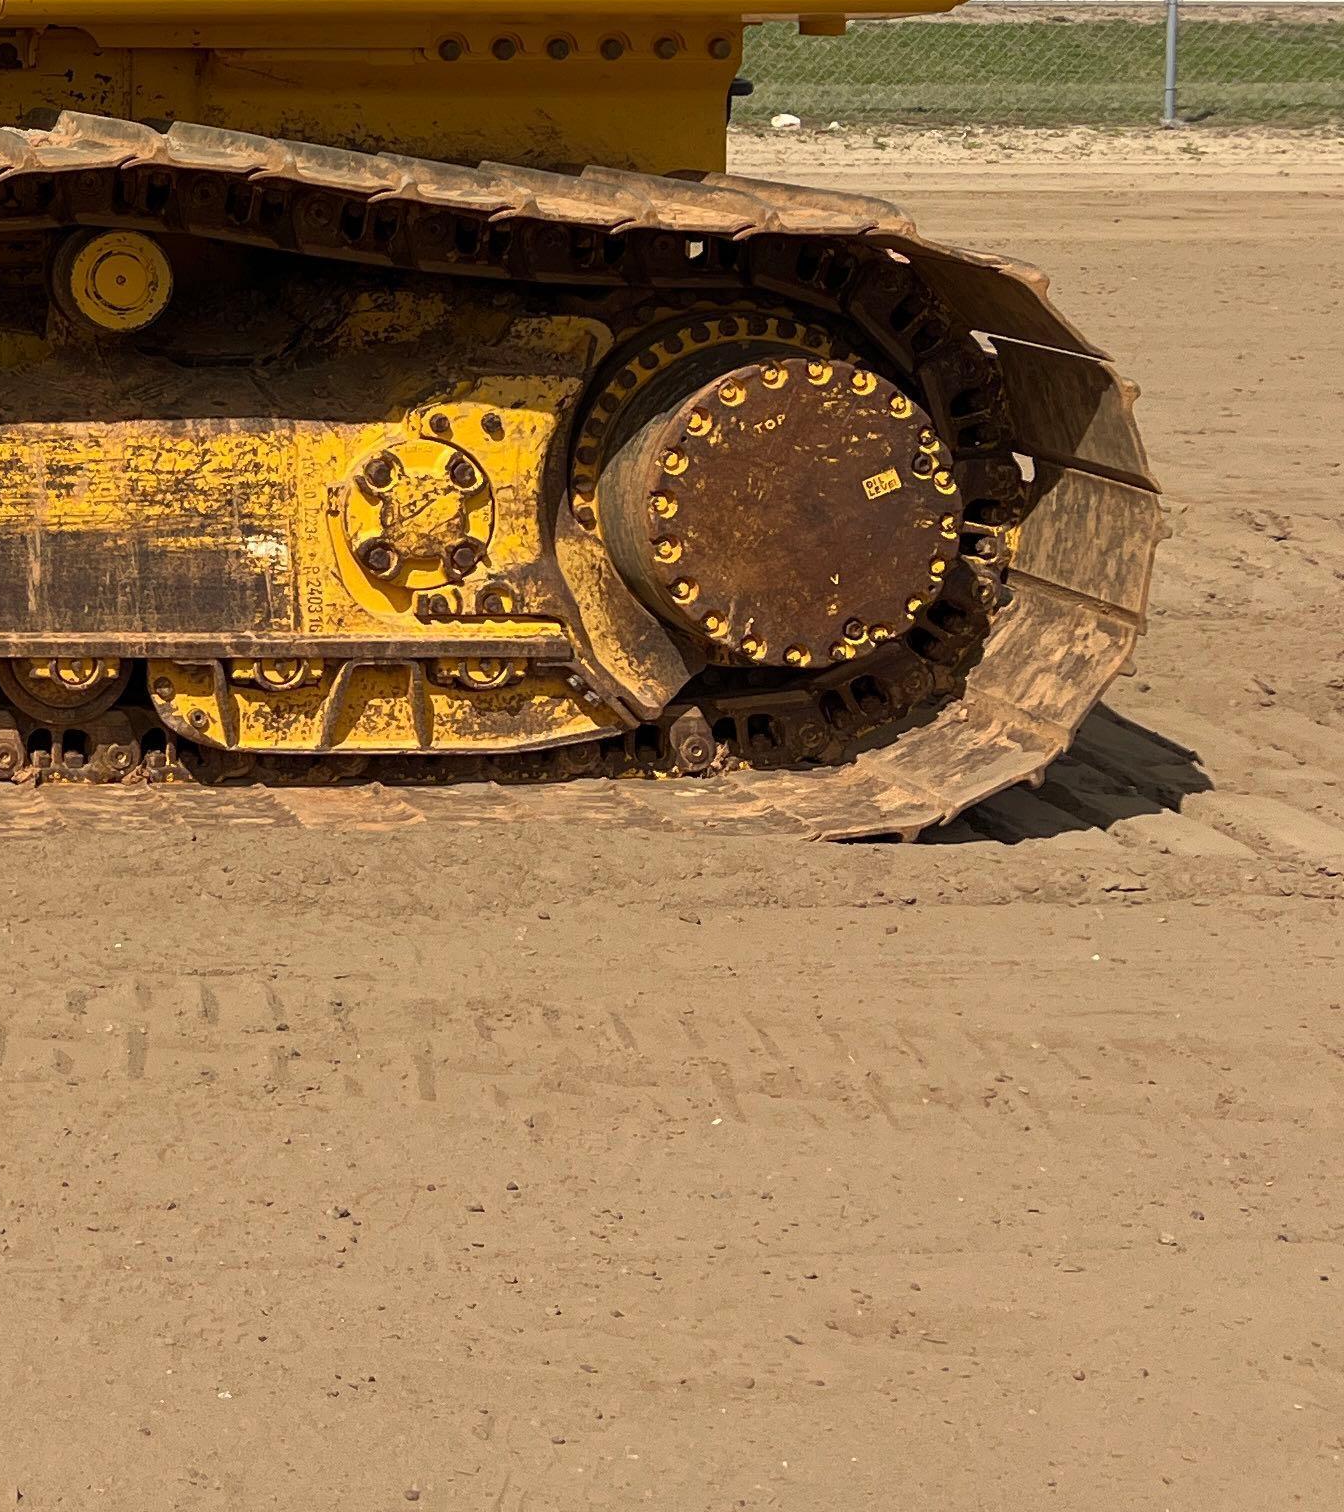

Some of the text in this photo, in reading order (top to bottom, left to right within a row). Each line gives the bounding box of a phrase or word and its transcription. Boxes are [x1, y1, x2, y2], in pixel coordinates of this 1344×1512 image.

[753, 414, 786, 434] TOP
[866, 476, 884, 489] OIL
[868, 478, 897, 497] LEVEL
